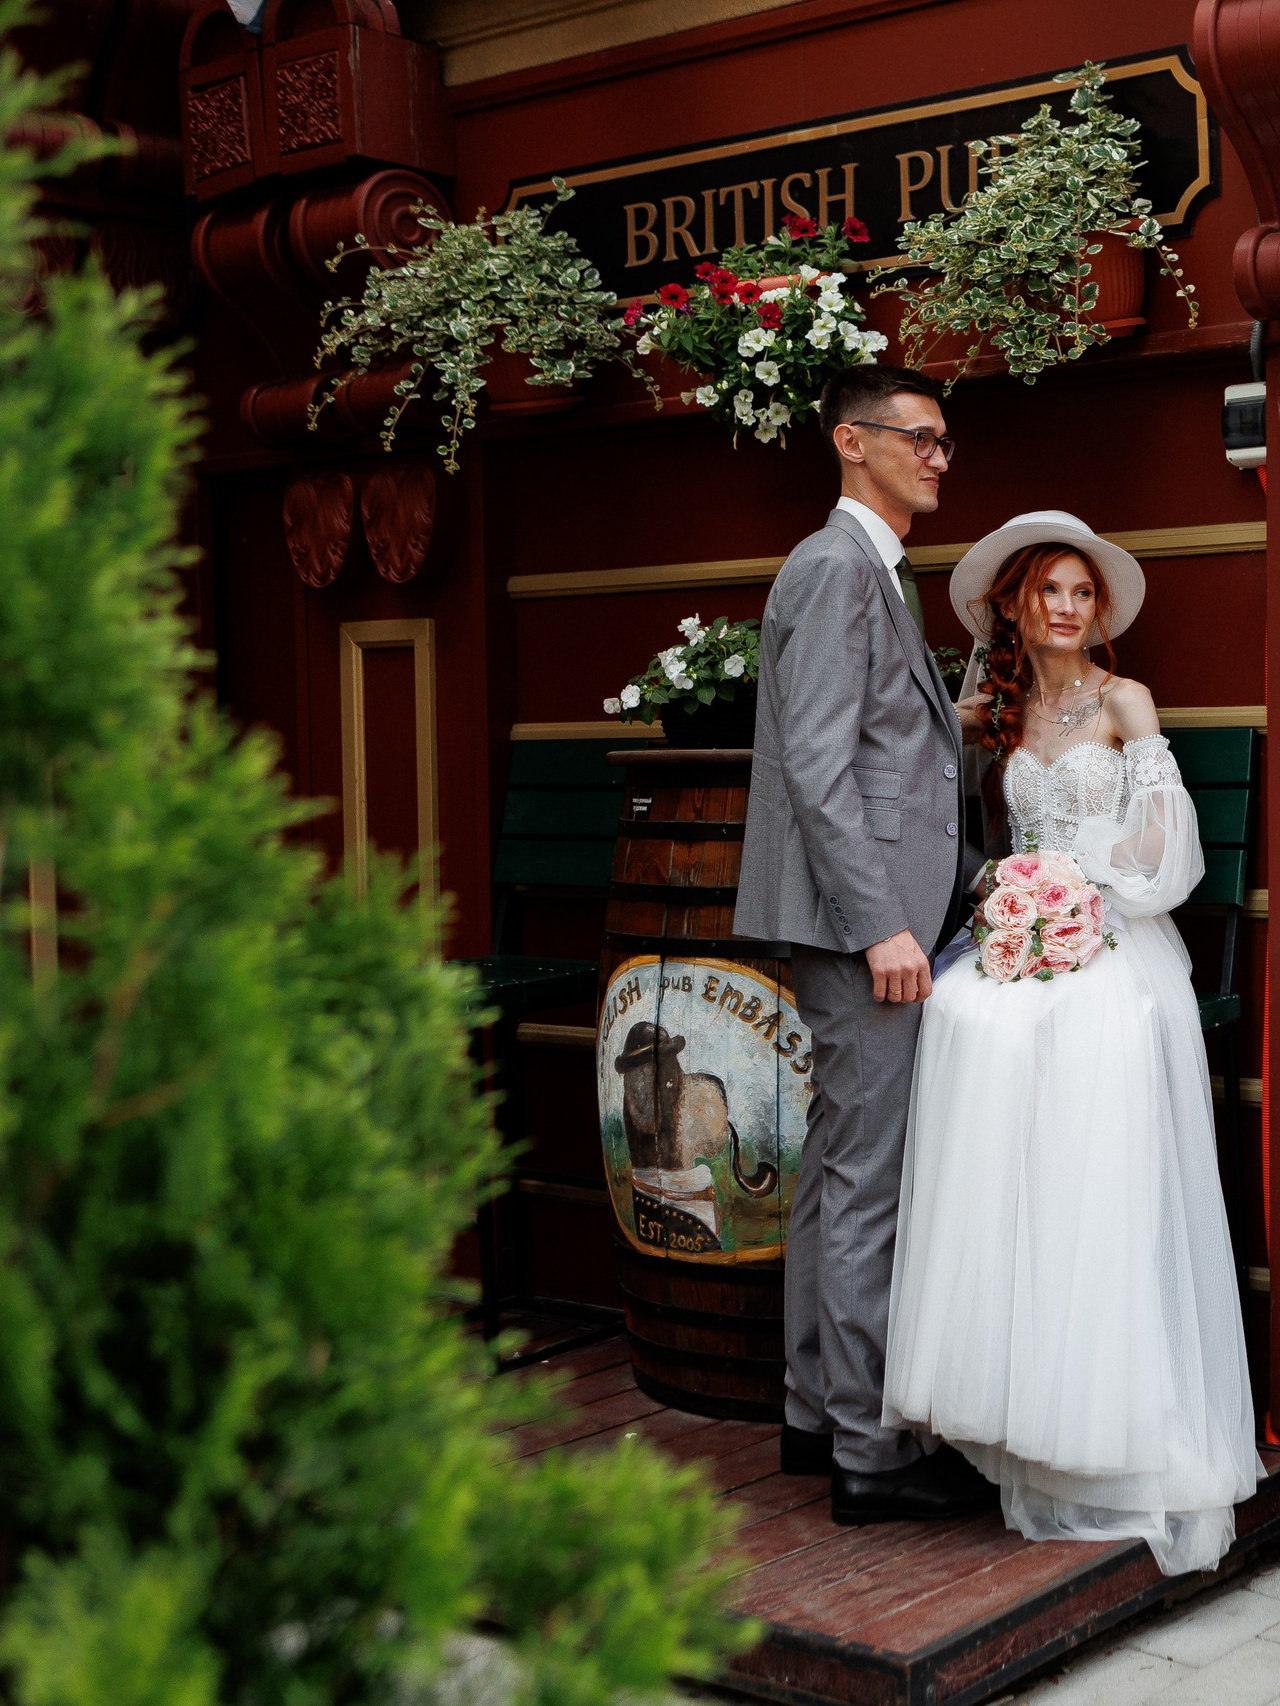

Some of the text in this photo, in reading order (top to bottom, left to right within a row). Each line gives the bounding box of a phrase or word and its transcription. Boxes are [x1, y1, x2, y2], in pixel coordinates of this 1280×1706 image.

[623, 162, 859, 268] BRITISH
[701, 975, 814, 1094] EMBASS
[669, 1232, 703, 1252] 2005
